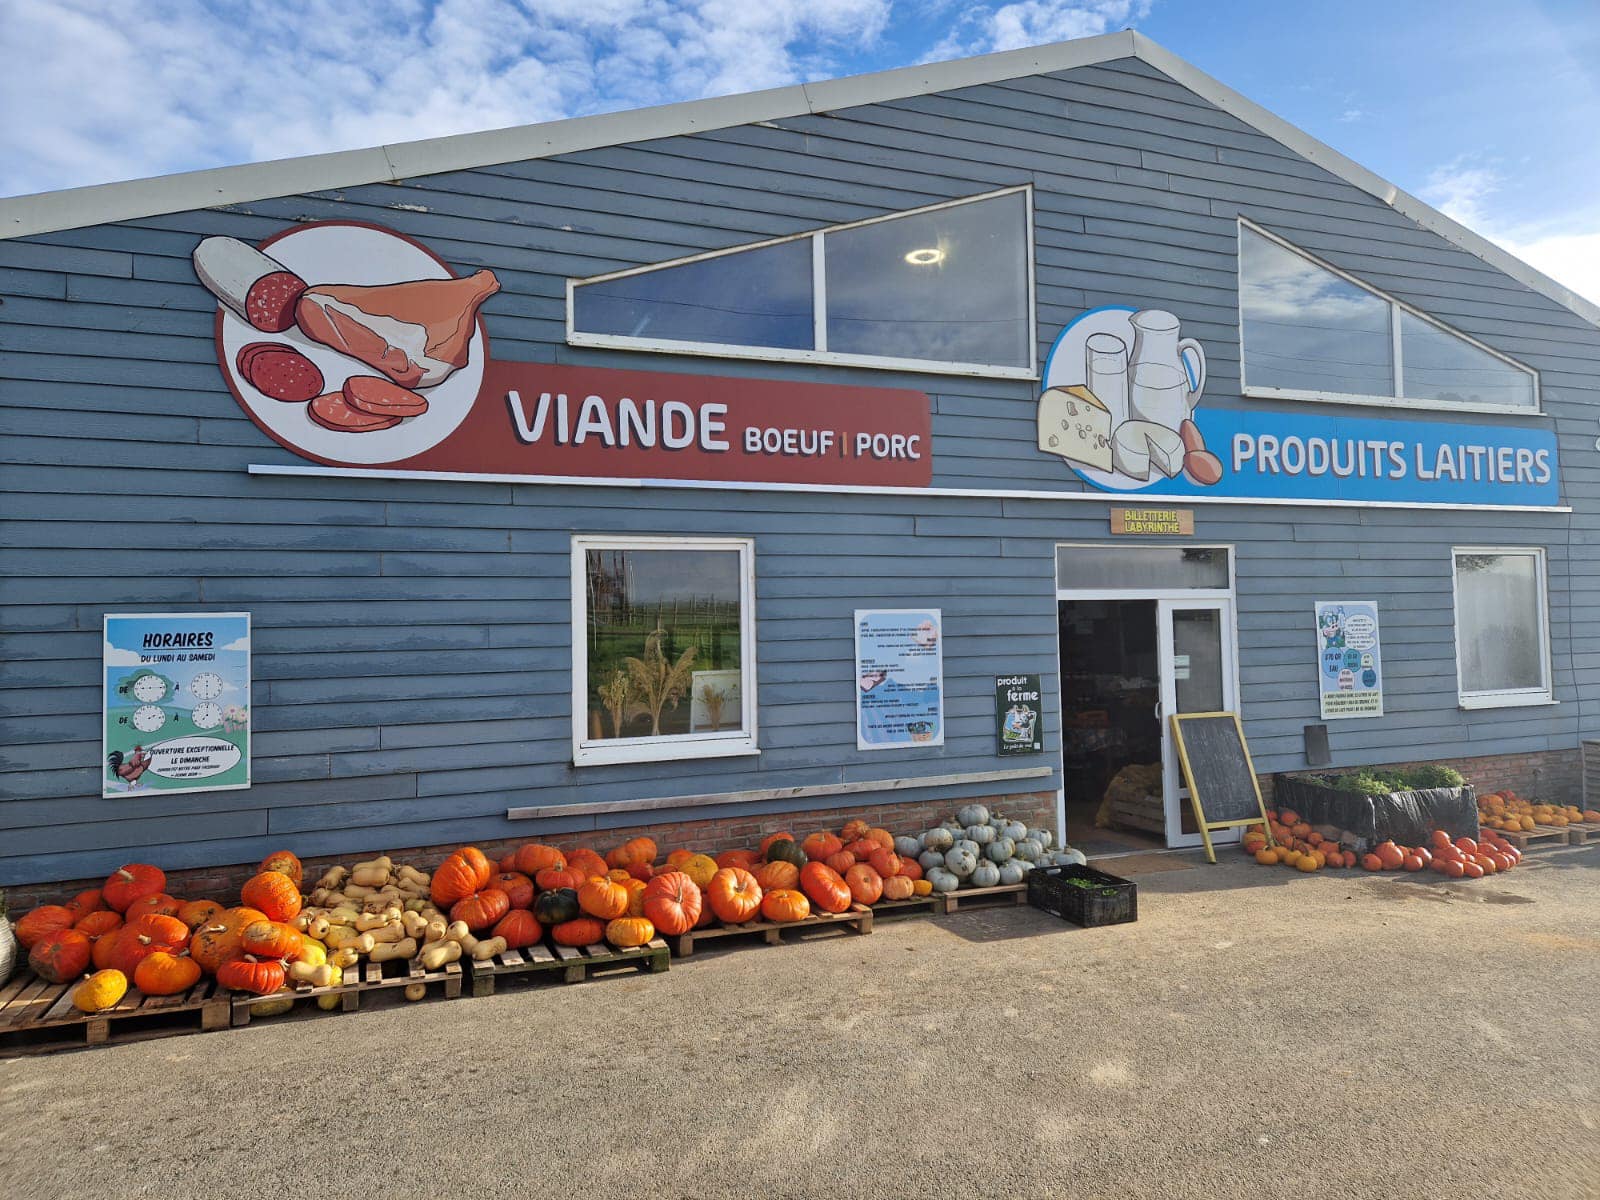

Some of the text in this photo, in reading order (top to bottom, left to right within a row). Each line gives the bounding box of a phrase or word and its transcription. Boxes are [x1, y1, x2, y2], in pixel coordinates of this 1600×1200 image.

[506, 390, 921, 460] VIANDE BOEUF PORC
[1232, 433, 1551, 485] PRODUITS LAITIERS
[1124, 510, 1177, 521] BILLETTERIE
[1125, 522, 1180, 533] LABYRINTHE
[143, 632, 214, 648] HORAIRES
[141, 655, 151, 663] DU
[177, 654, 187, 662] AU
[189, 653, 216, 662] SAMEDI
[997, 676, 1027, 687] produit
[119, 686, 128, 694] DE
[1007, 690, 1039, 702] ferme
[150, 745, 235, 755] OUVERTURE EXCEPTIONNELLE
[179, 756, 210, 764] DIMANCHE
